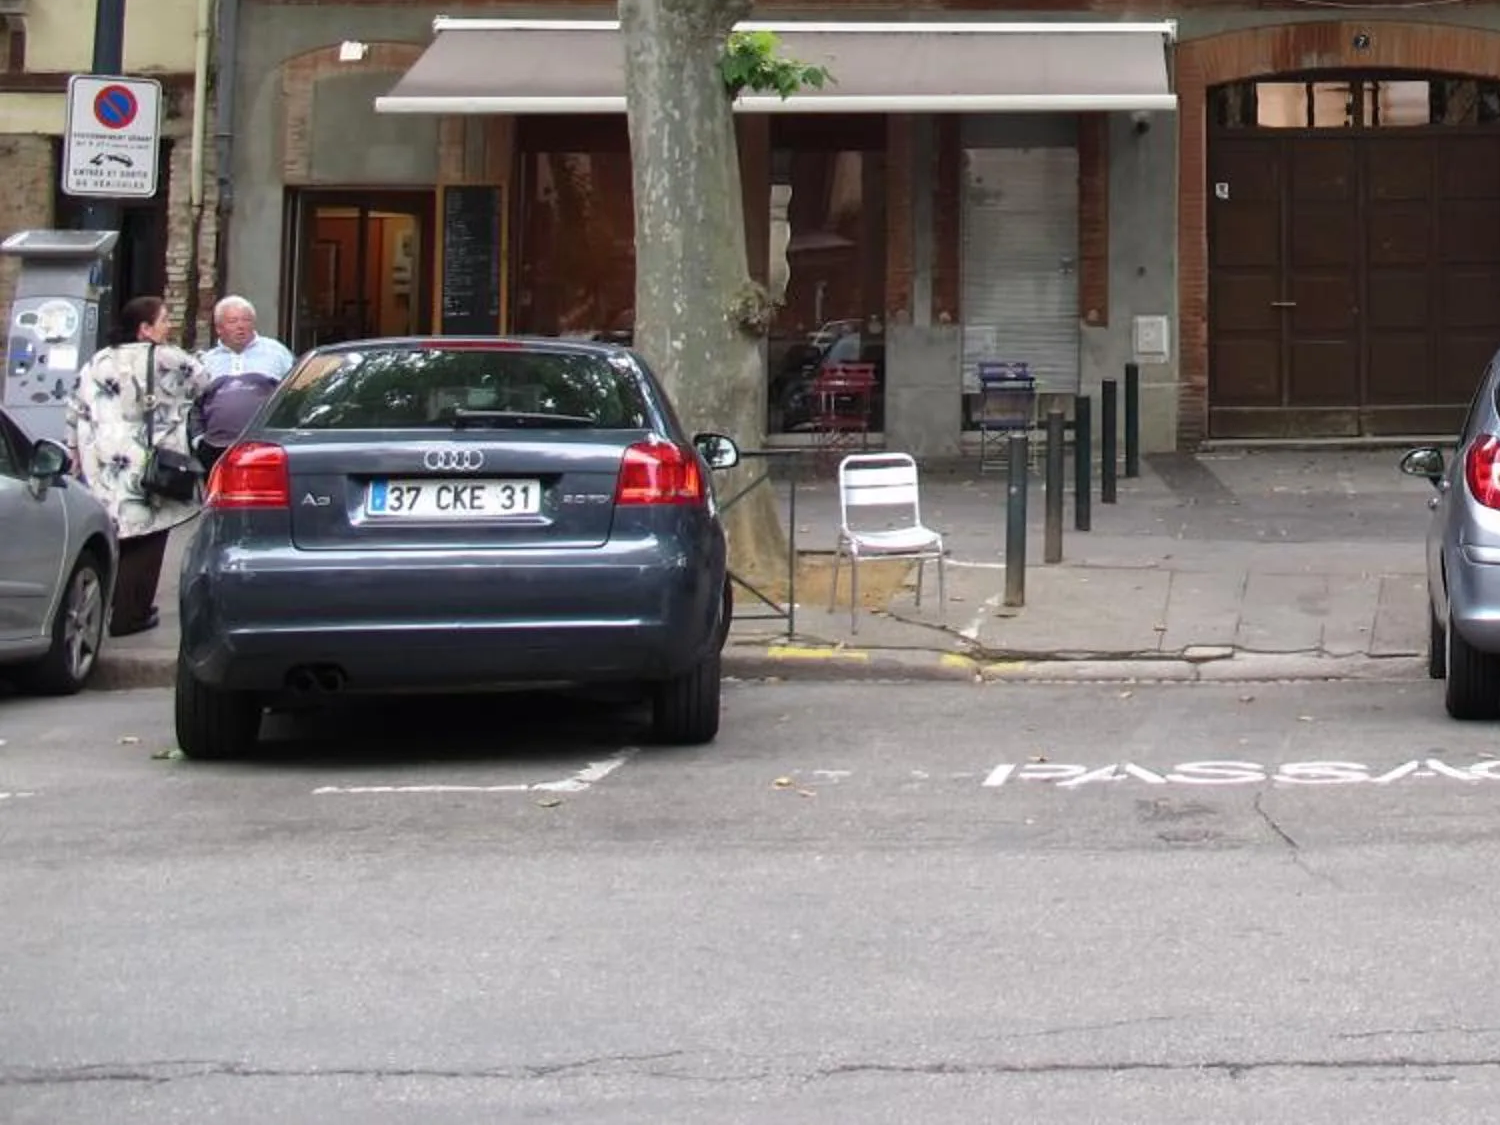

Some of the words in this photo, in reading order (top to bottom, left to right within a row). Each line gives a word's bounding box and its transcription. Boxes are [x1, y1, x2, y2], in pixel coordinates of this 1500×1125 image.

[388, 486, 421, 511] 37
[436, 486, 486, 511] CKE
[500, 485, 530, 511] 31
